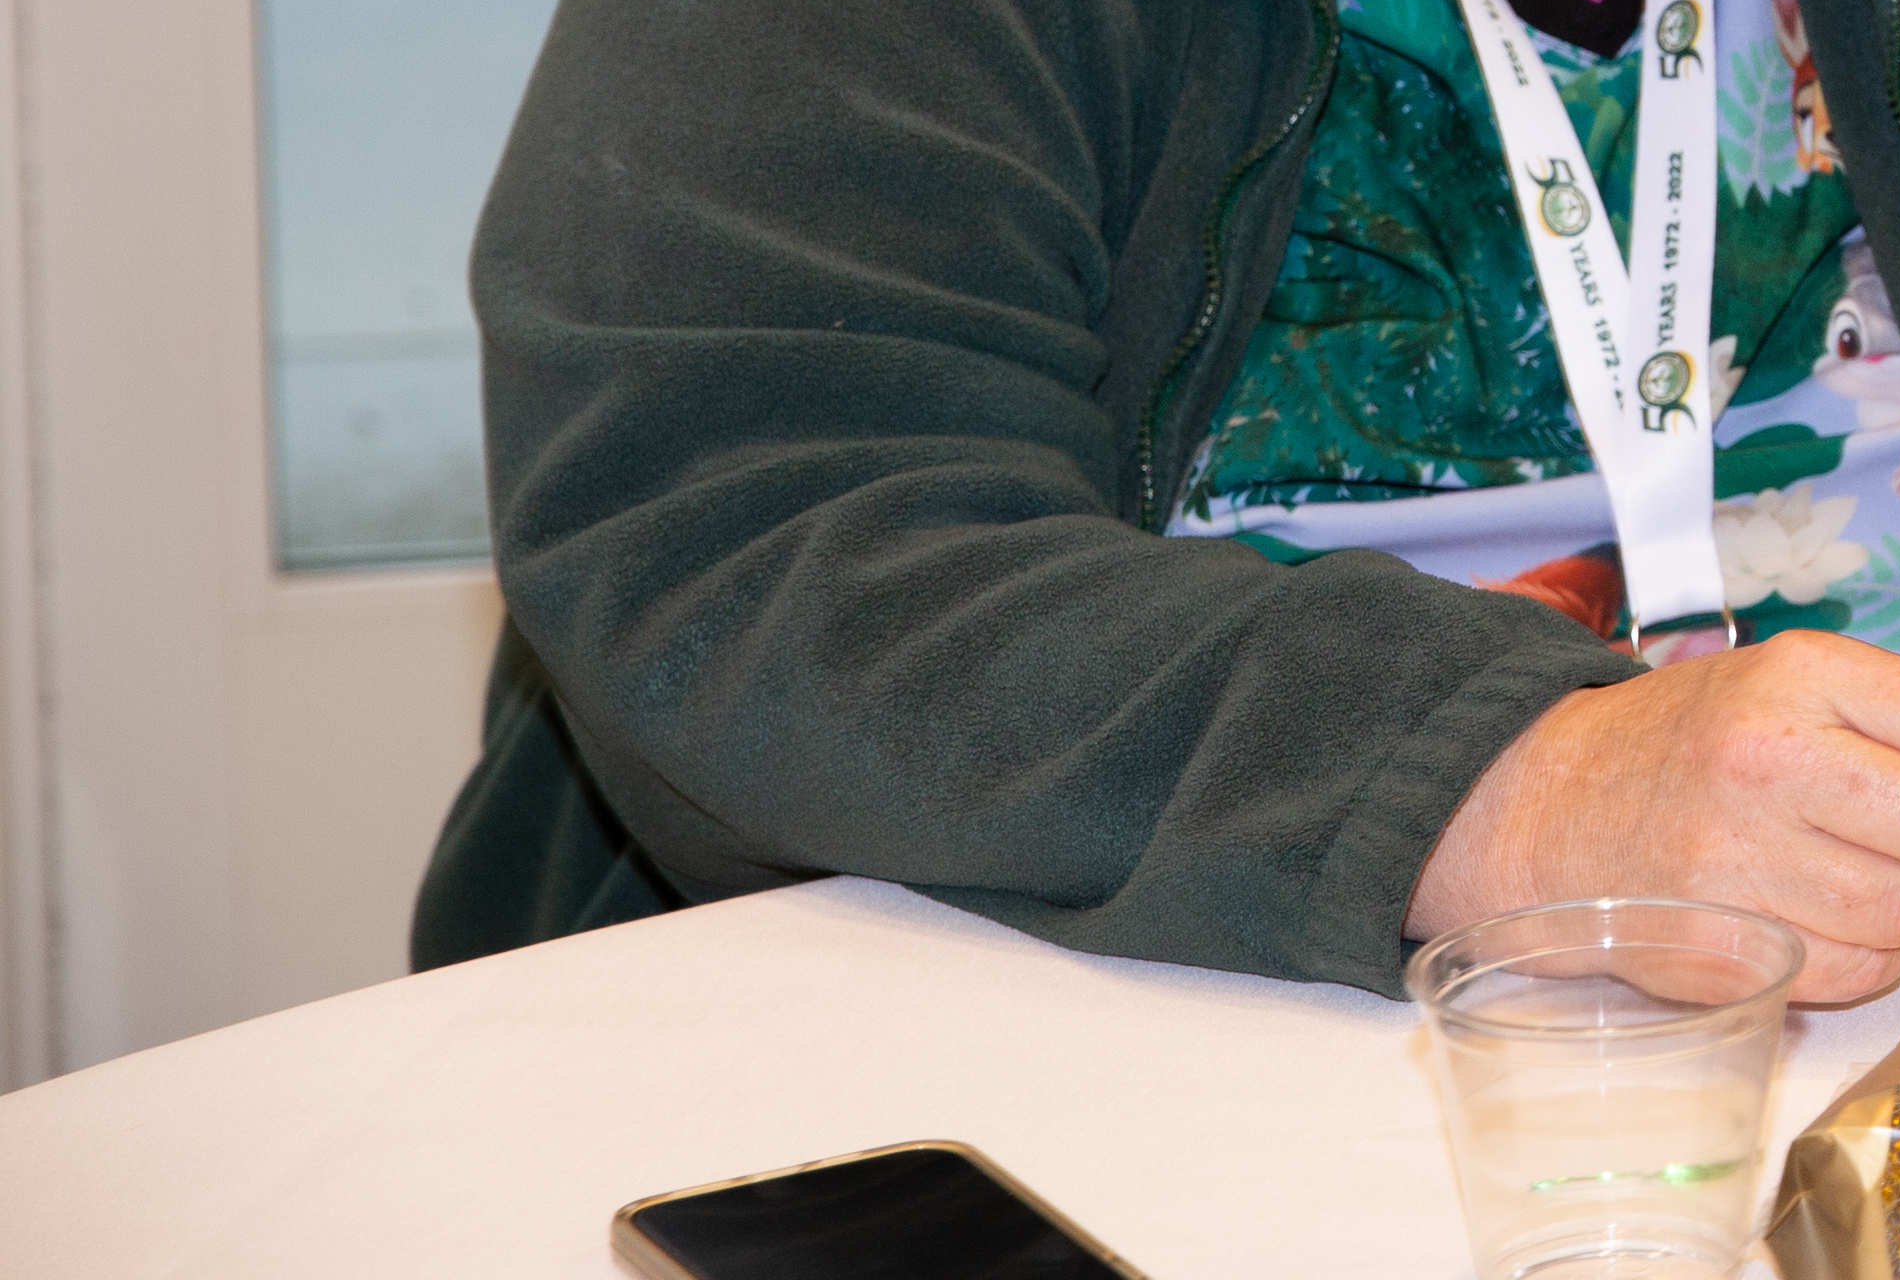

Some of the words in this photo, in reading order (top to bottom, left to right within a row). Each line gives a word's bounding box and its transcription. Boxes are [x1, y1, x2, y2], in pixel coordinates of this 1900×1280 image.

[1667, 150, 1683, 201] 2022
[1664, 221, 1681, 271] 1972
[1569, 239, 1604, 307] YEARS
[1593, 317, 1621, 370] 1972
[1658, 280, 1677, 346] YEARS
